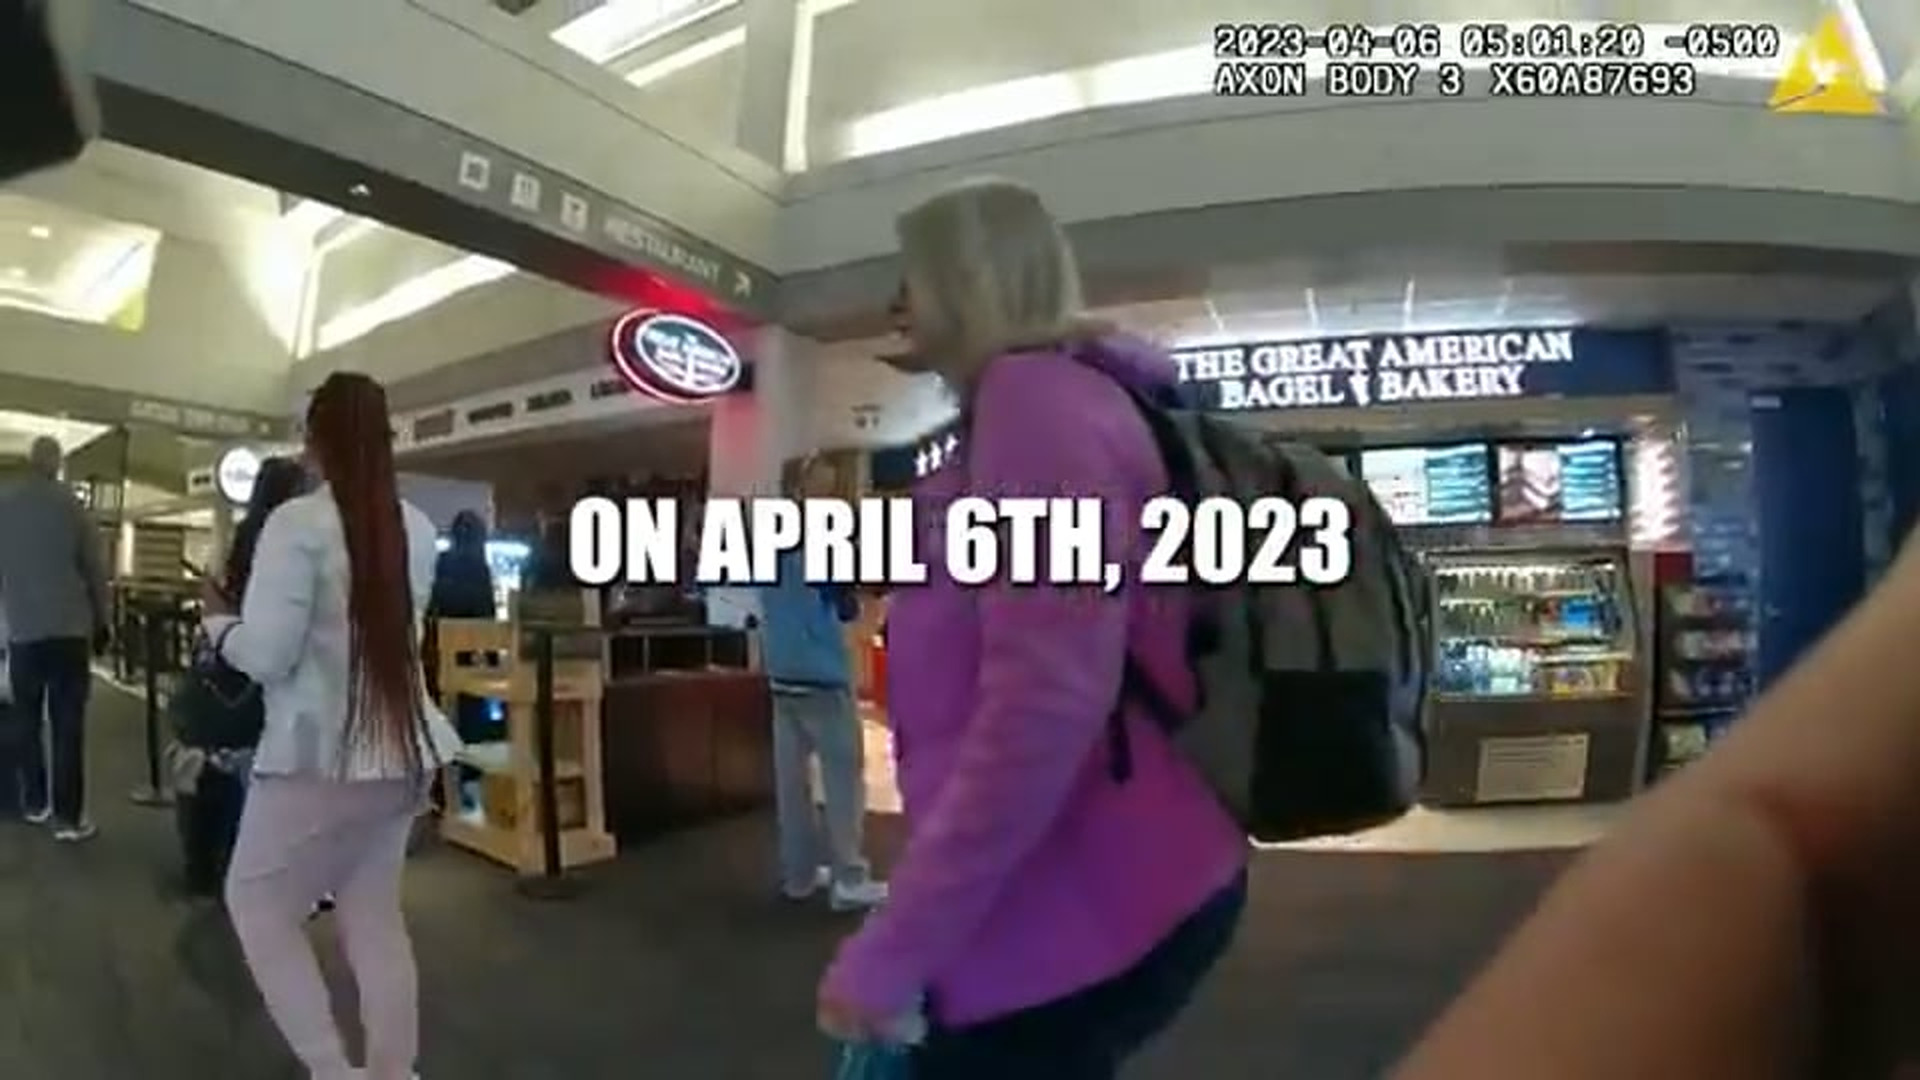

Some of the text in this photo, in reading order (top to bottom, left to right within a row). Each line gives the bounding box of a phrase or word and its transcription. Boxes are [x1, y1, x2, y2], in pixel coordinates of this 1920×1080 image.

[1171, 331, 1573, 383] THE GREAT AMERICAN
[1220, 363, 1525, 409] BAGEL BAKERY
